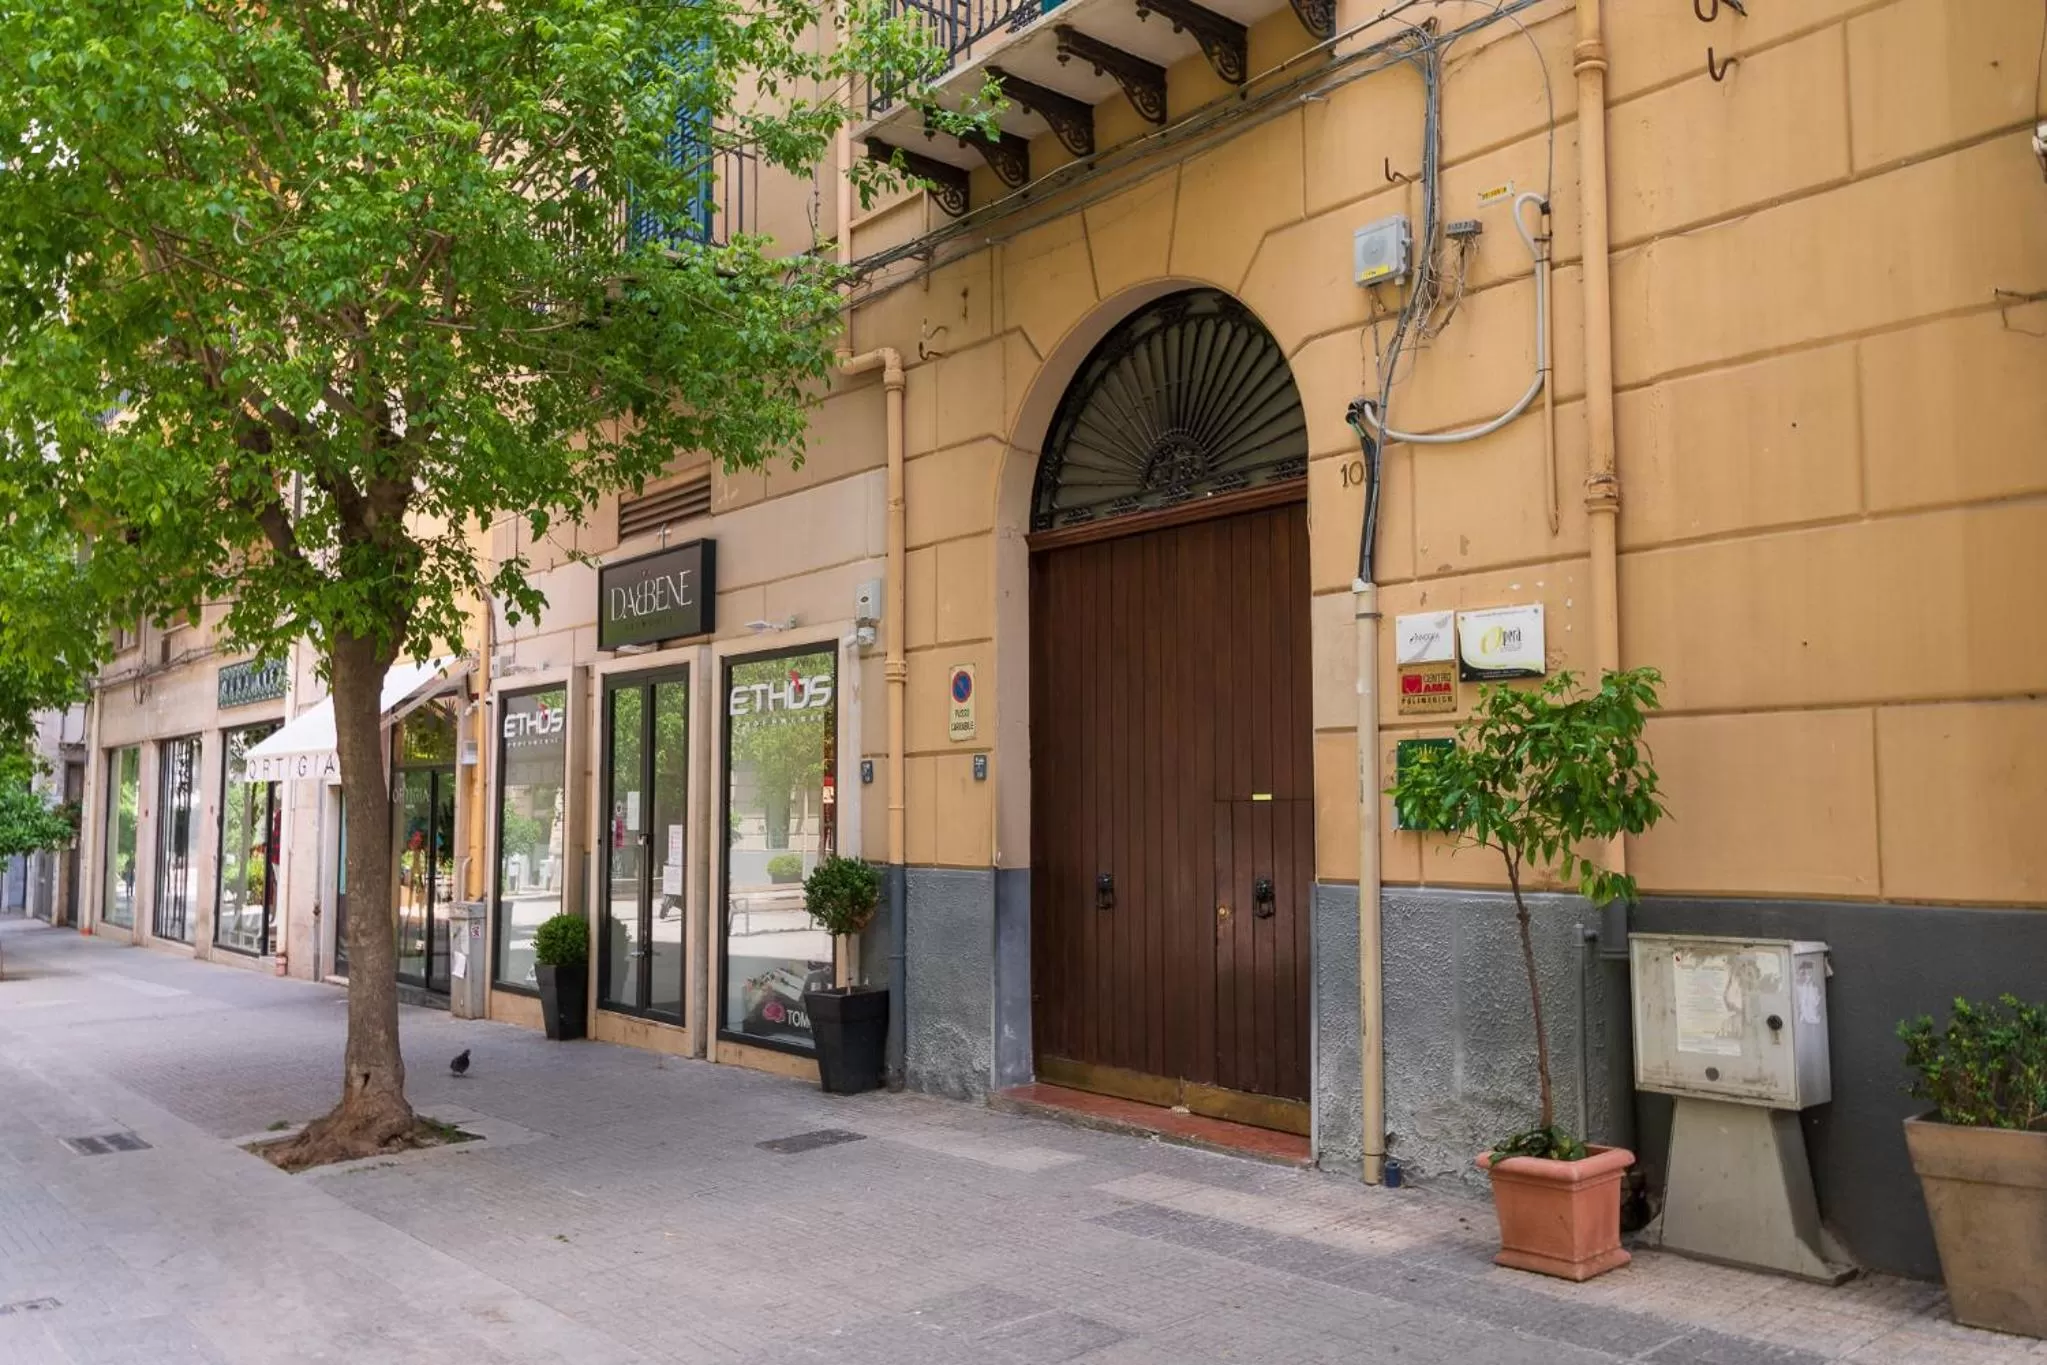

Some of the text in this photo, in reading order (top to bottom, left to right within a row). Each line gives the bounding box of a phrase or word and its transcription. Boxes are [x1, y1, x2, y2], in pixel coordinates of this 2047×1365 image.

[1340, 460, 1364, 488] 10
[730, 675, 832, 716] ETHOS
[1424, 682, 1452, 693] AMA
[503, 708, 563, 738] ETHOS
[248, 754, 336, 780] ORTIGIA
